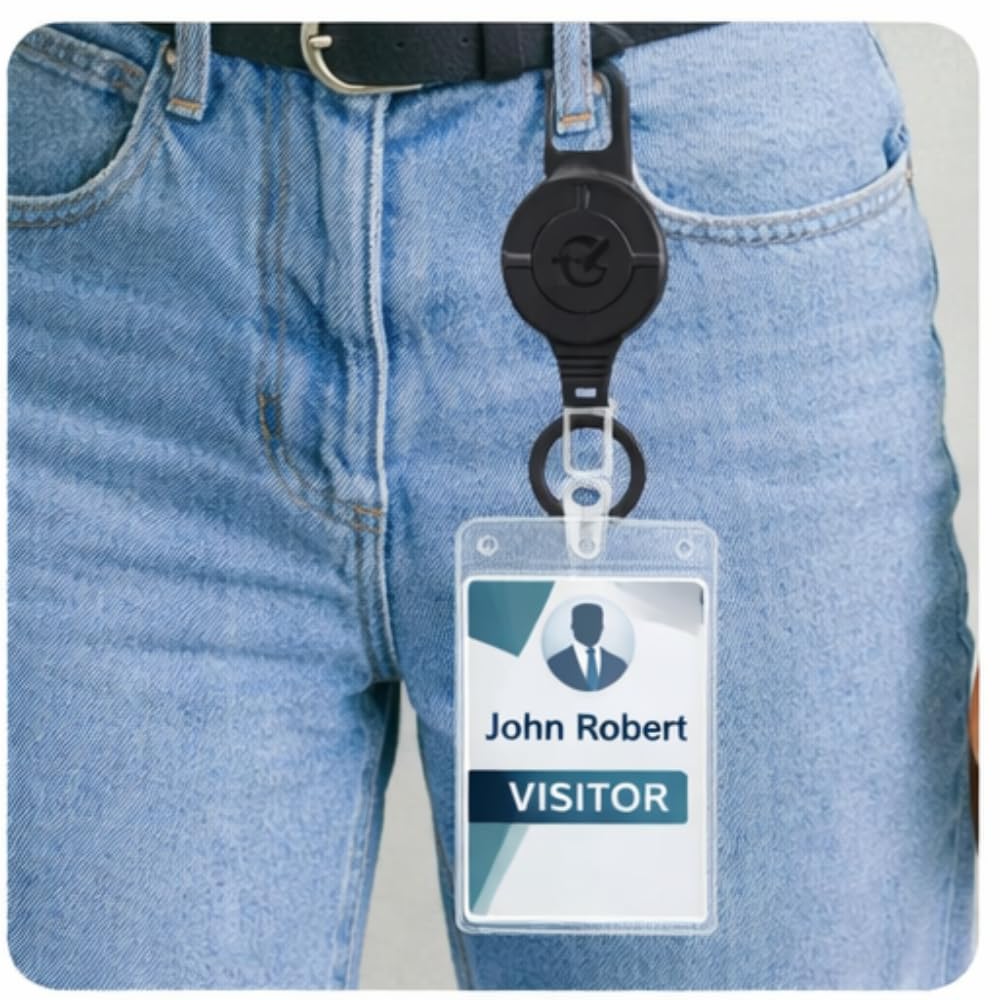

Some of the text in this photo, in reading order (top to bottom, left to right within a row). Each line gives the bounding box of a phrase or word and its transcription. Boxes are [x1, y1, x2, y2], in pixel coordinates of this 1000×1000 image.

[485, 712, 688, 741] John Robert
[508, 781, 669, 813] VISITOR
